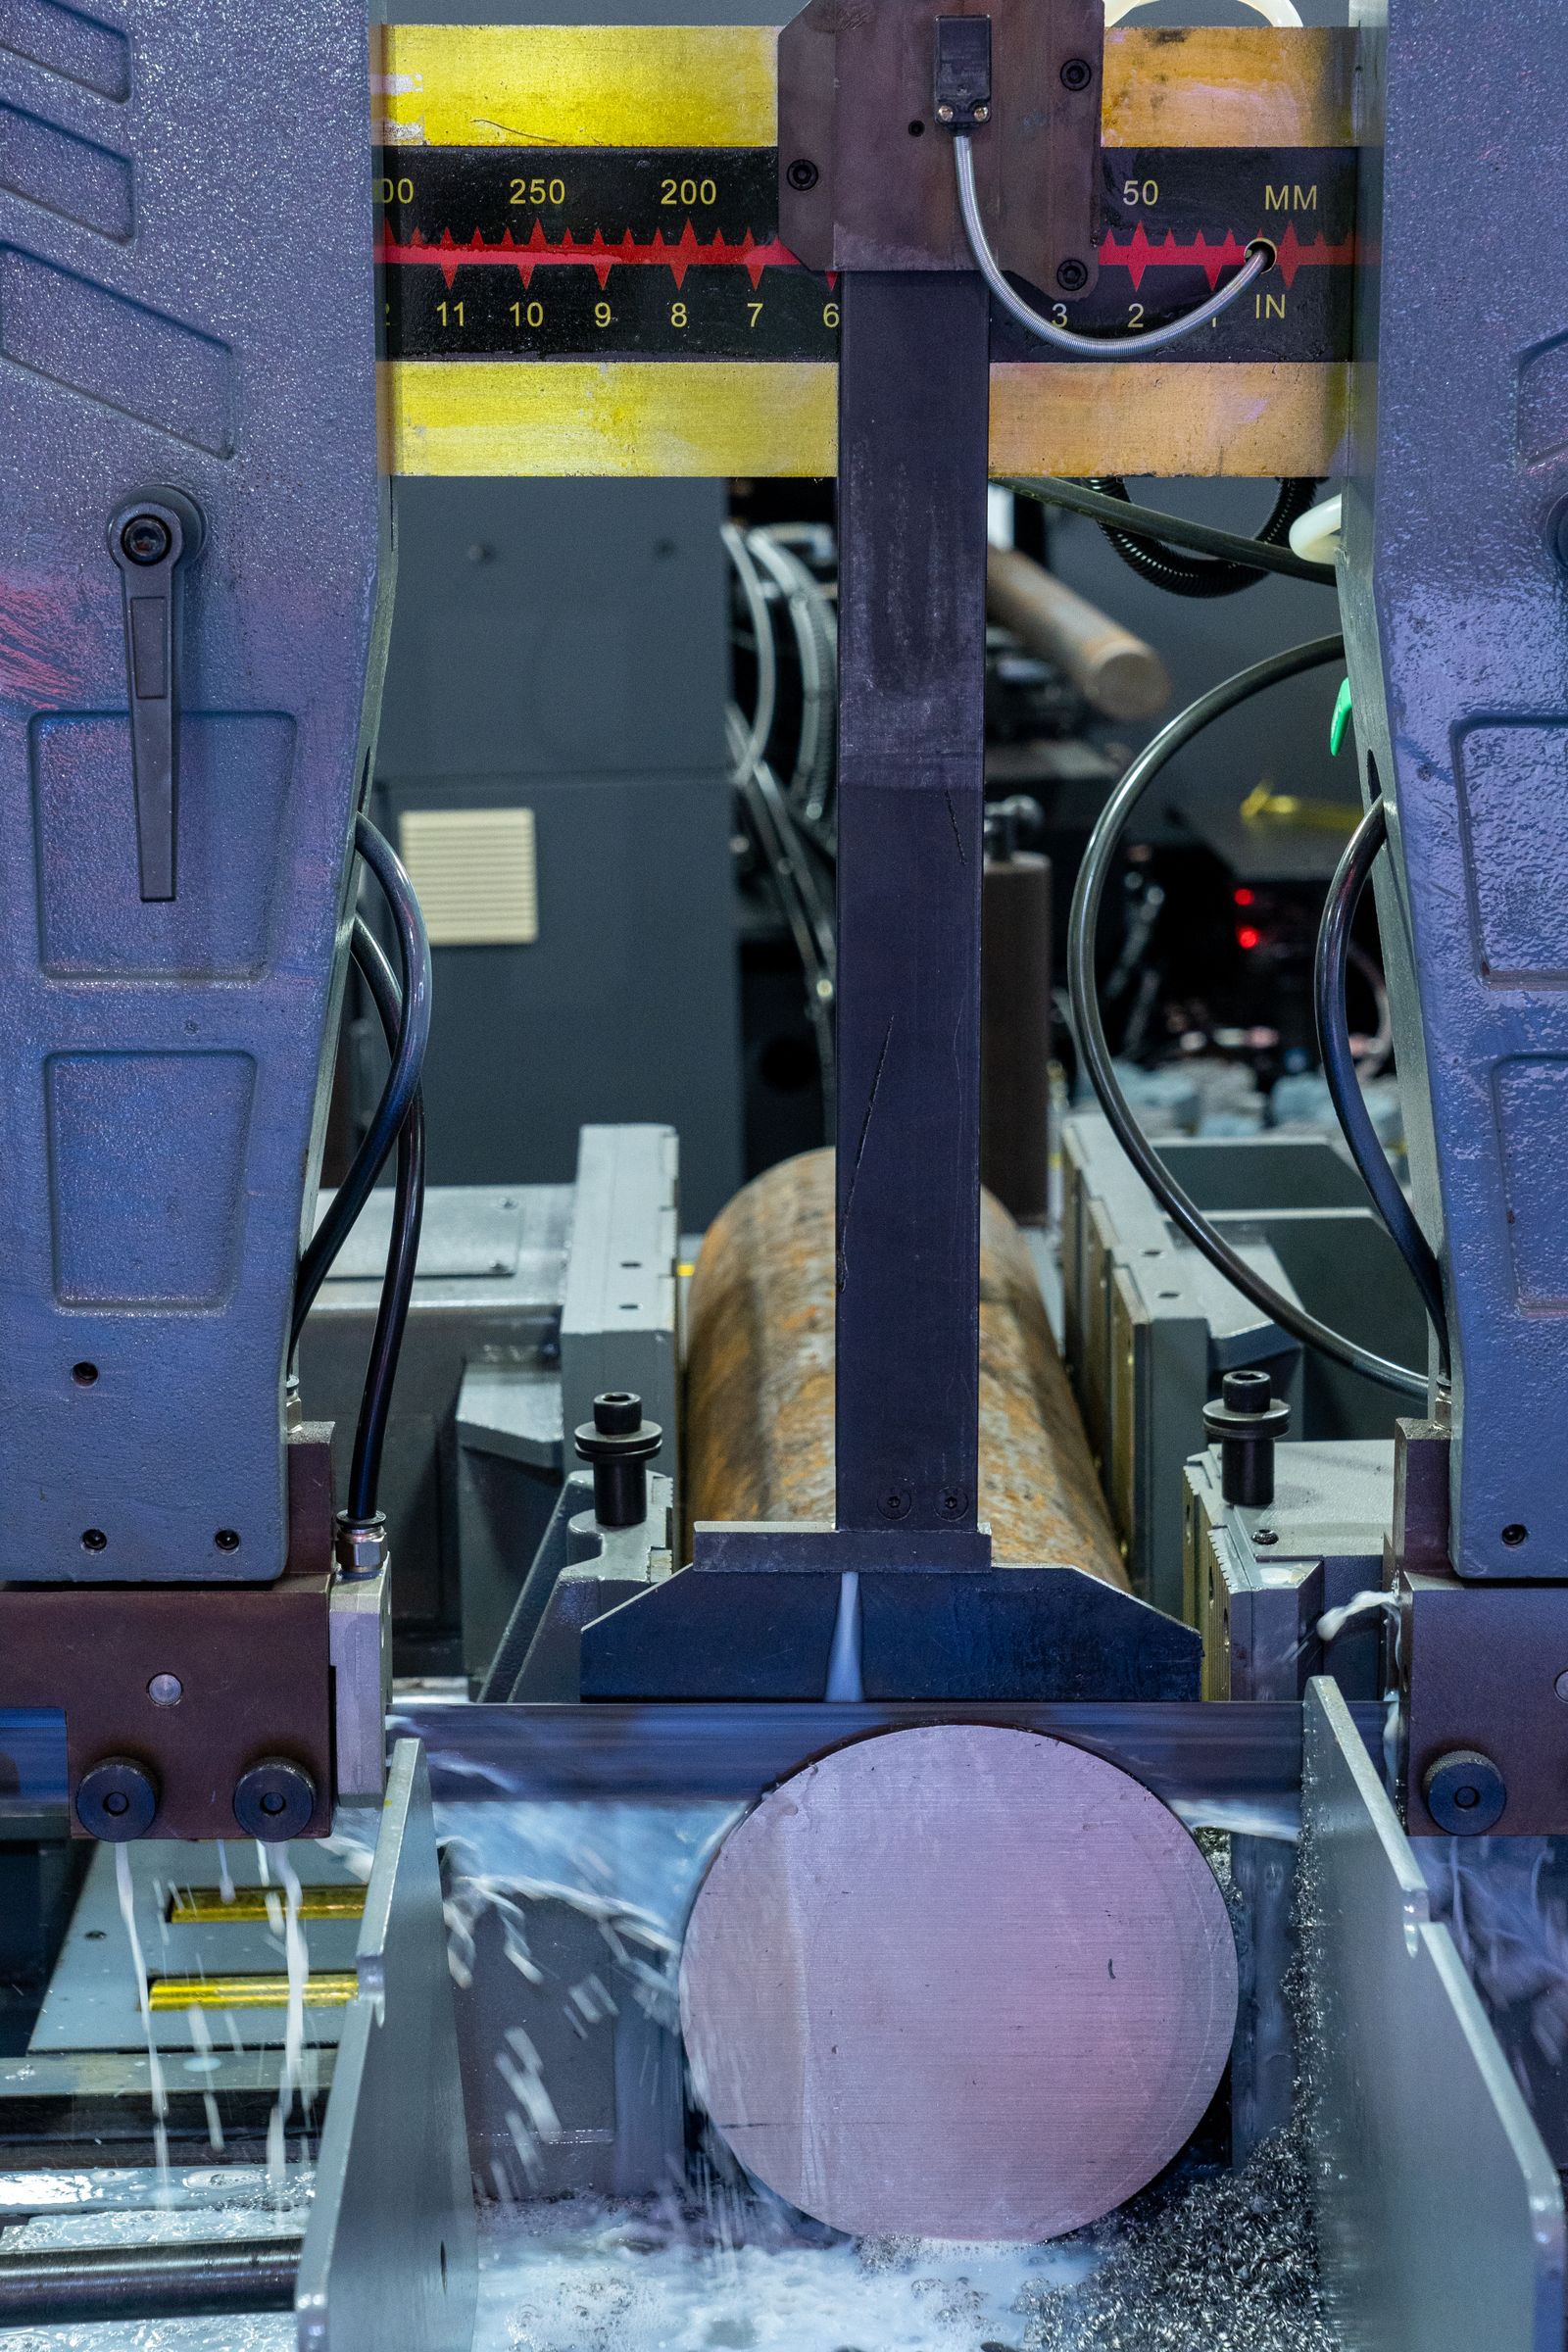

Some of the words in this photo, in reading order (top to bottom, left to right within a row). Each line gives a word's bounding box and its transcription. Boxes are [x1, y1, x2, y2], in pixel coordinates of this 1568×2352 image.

[509, 177, 566, 205] 250
[660, 178, 717, 206] 200
[1122, 179, 1159, 207] 50
[1264, 184, 1318, 211] MM
[435, 301, 466, 327] 11
[509, 301, 545, 327] 10
[594, 301, 612, 328] 9
[669, 302, 688, 328] 8
[746, 302, 764, 328] 7
[822, 302, 841, 328] 6
[1051, 303, 1069, 329] 3
[1127, 302, 1145, 328] 2
[1254, 293, 1287, 319] IN
